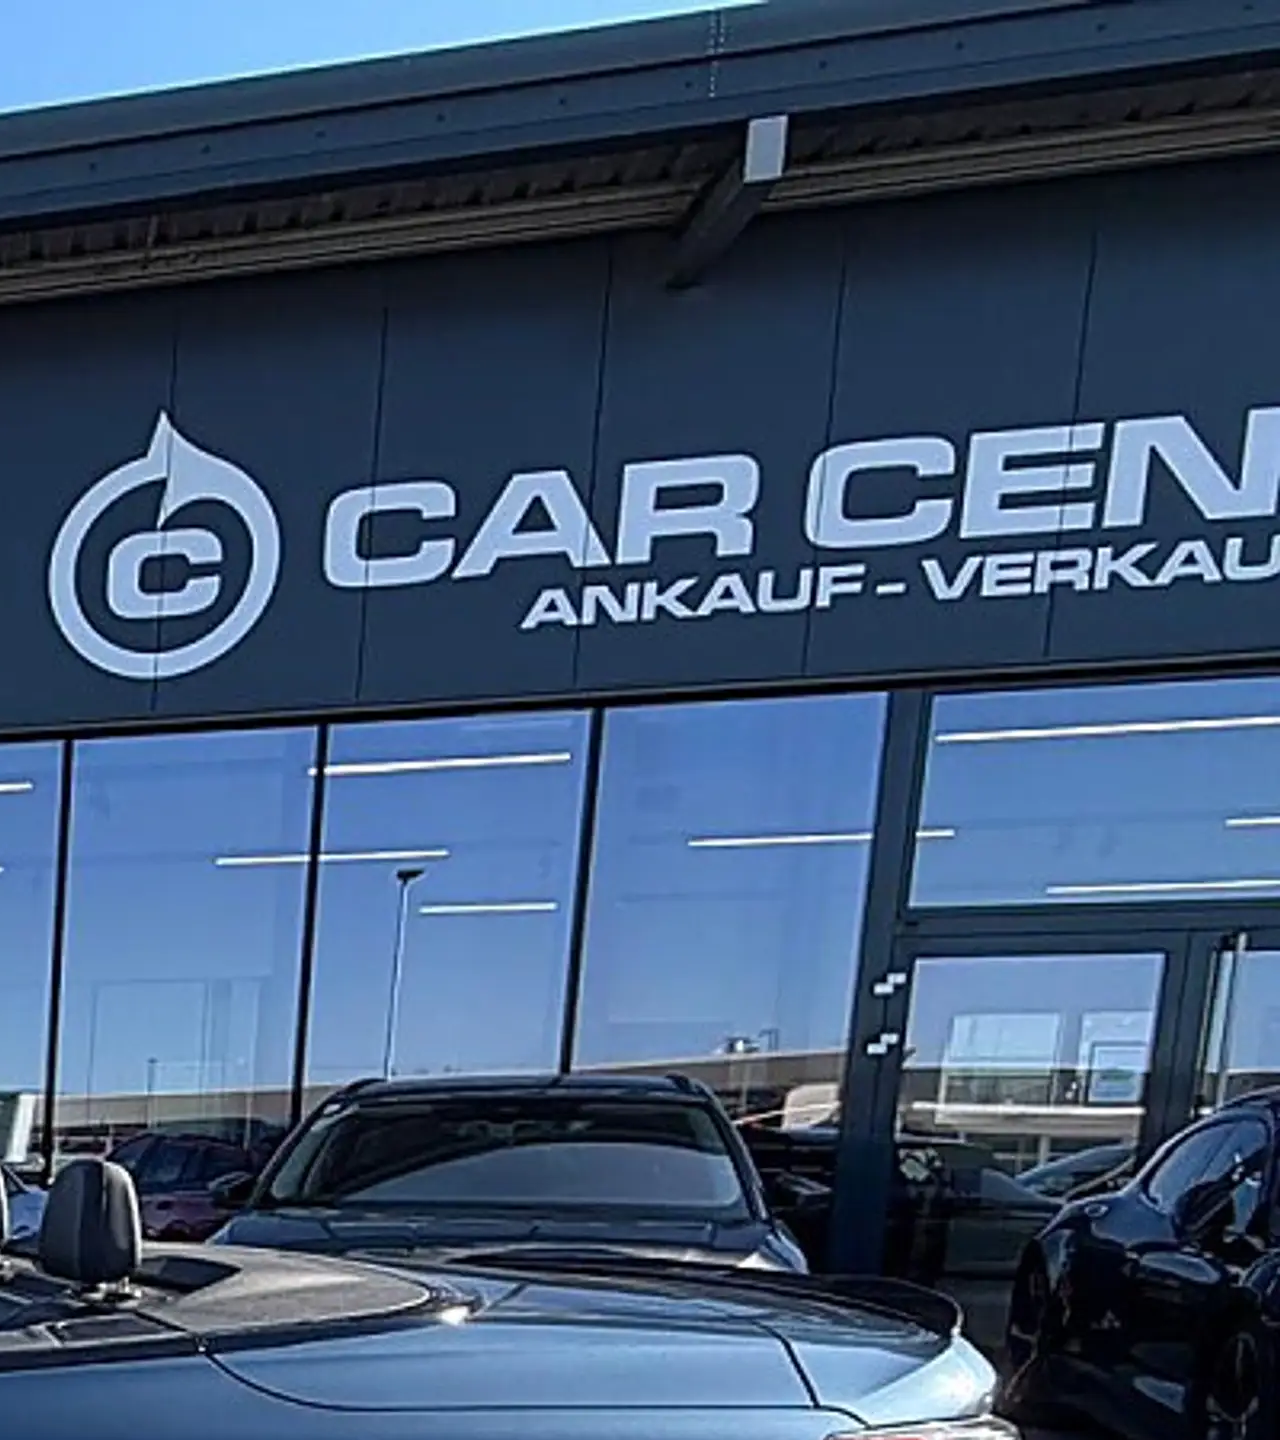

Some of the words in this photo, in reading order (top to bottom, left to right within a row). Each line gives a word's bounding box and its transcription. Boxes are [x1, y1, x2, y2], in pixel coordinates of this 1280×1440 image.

[323, 453, 761, 589] CAR
[805, 404, 1280, 549] CEN
[520, 564, 867, 630] ANKAUF
[921, 533, 1280, 601] VERKAU
